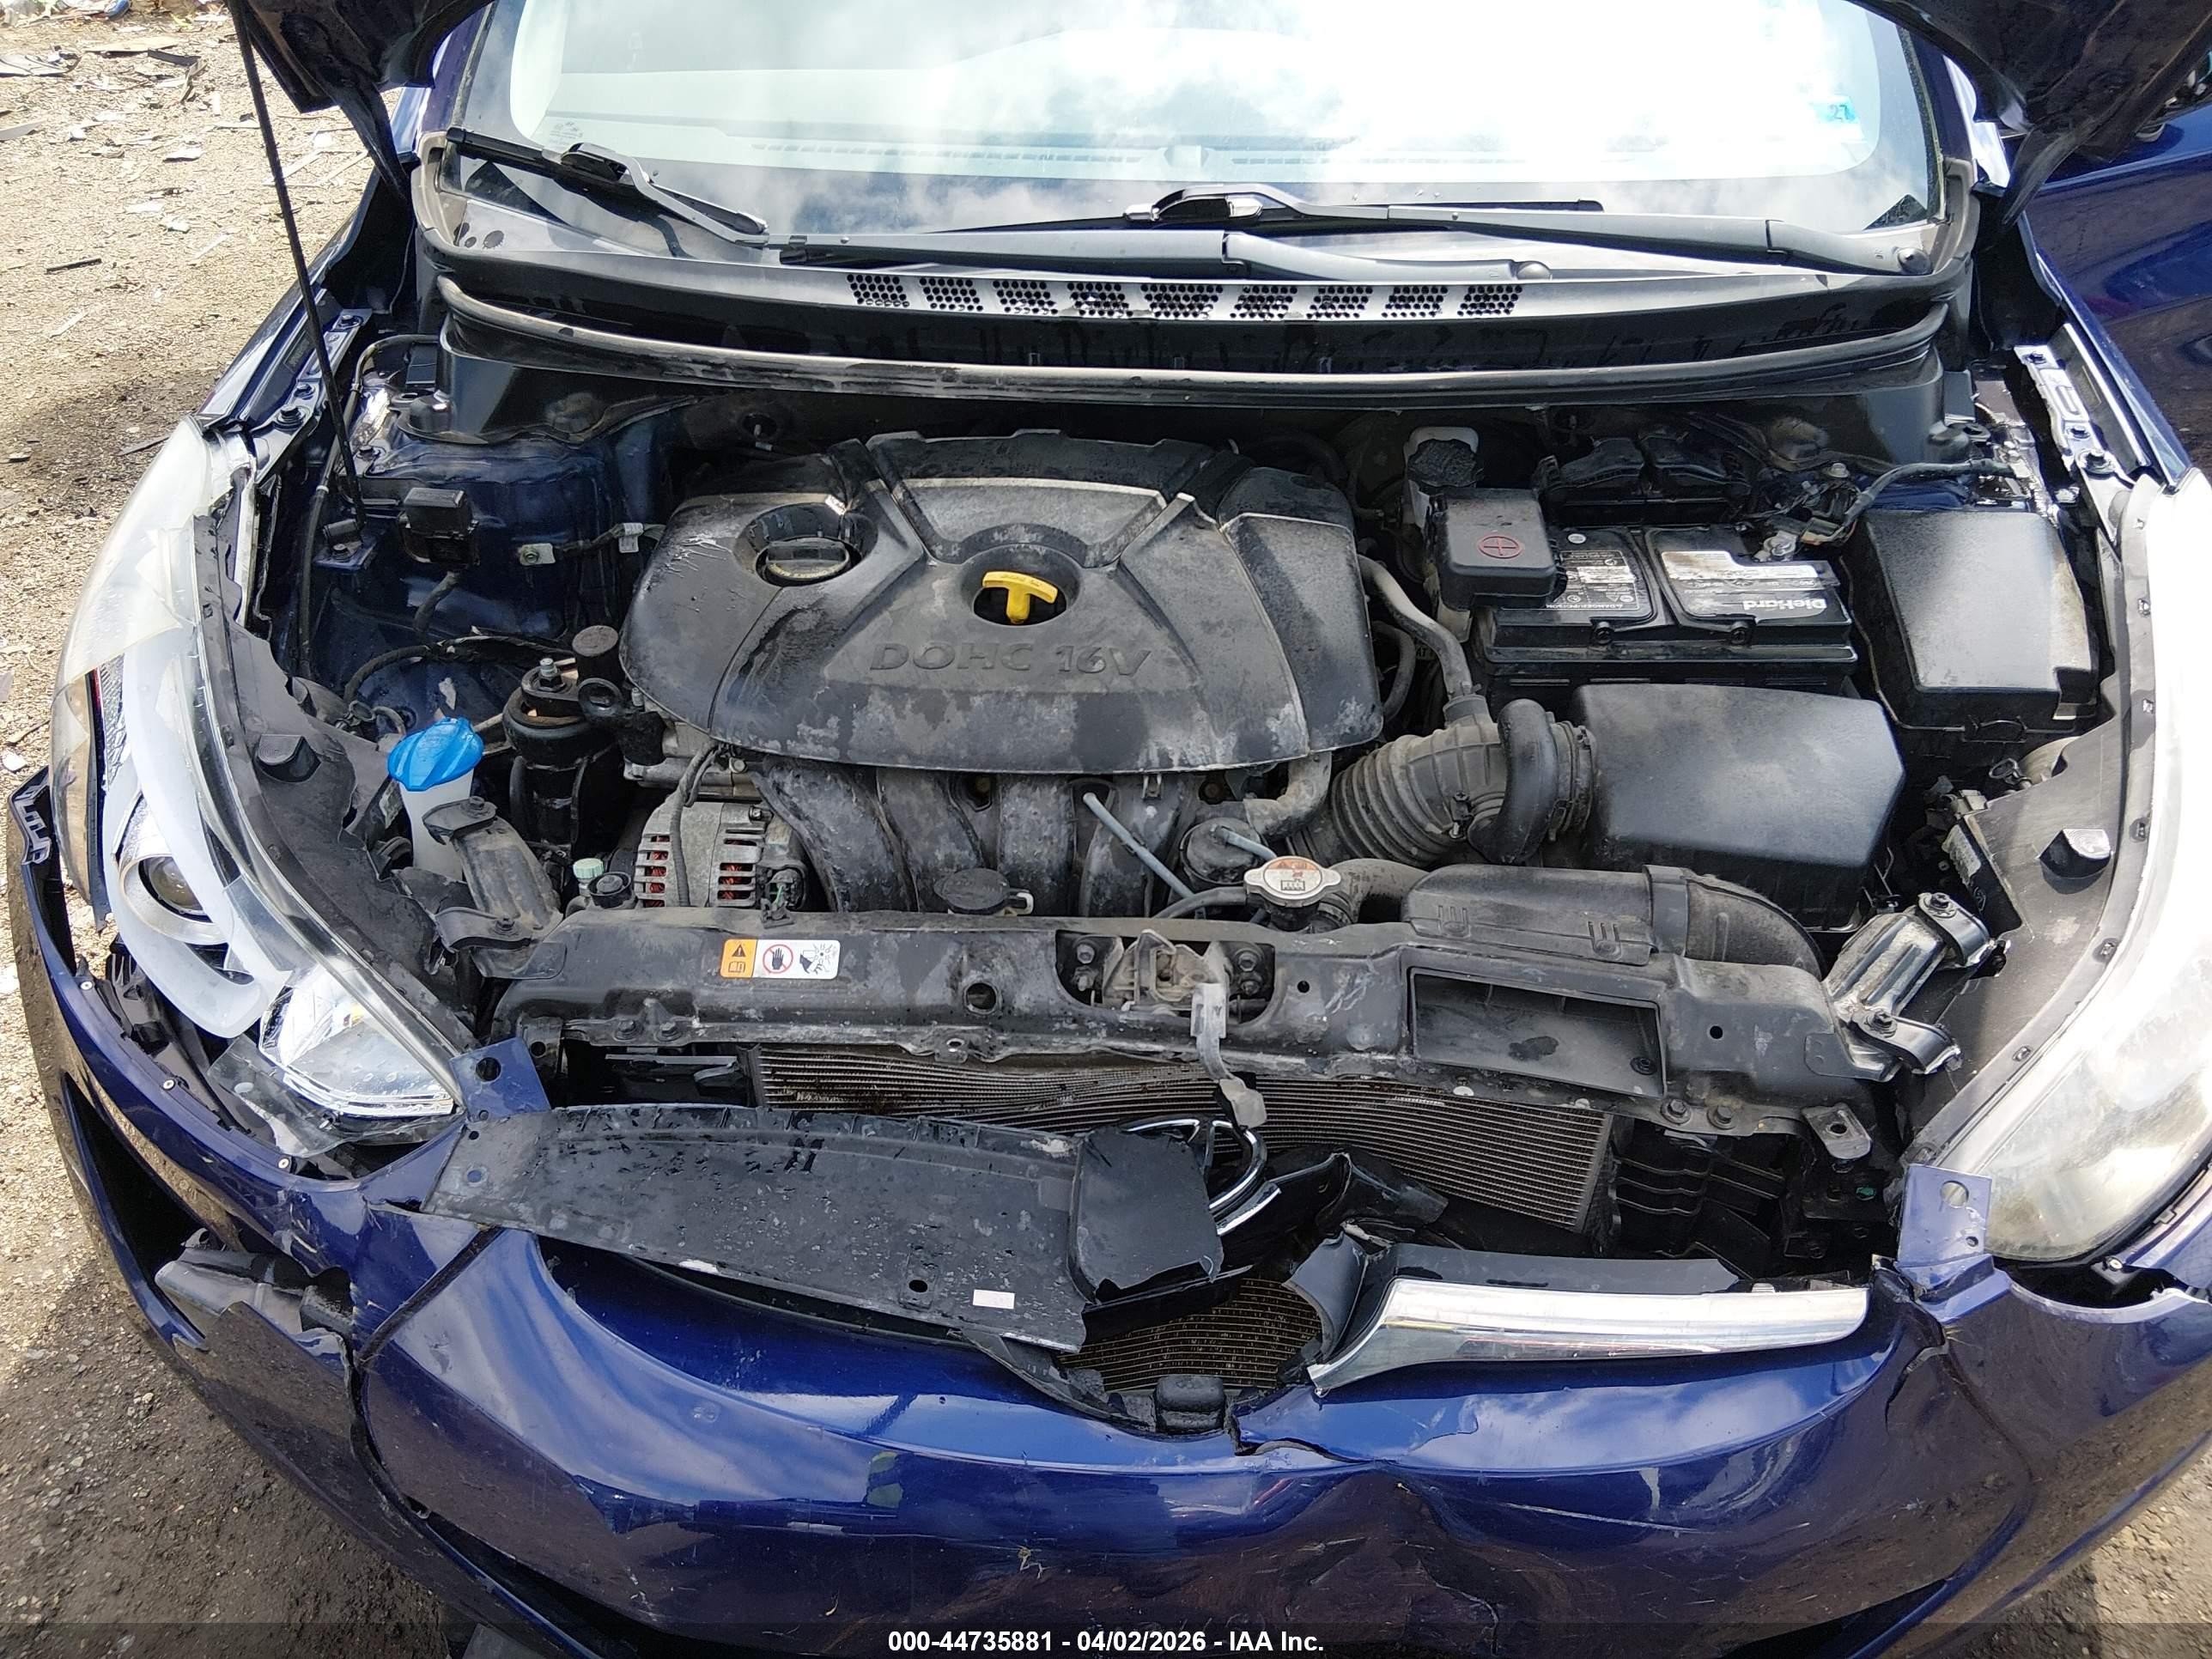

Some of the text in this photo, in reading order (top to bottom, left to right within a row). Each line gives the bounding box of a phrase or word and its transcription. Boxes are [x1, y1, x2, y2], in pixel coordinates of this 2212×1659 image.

[1742, 599, 1827, 611] DieHard
[870, 643, 1152, 677] DOHC 16V
